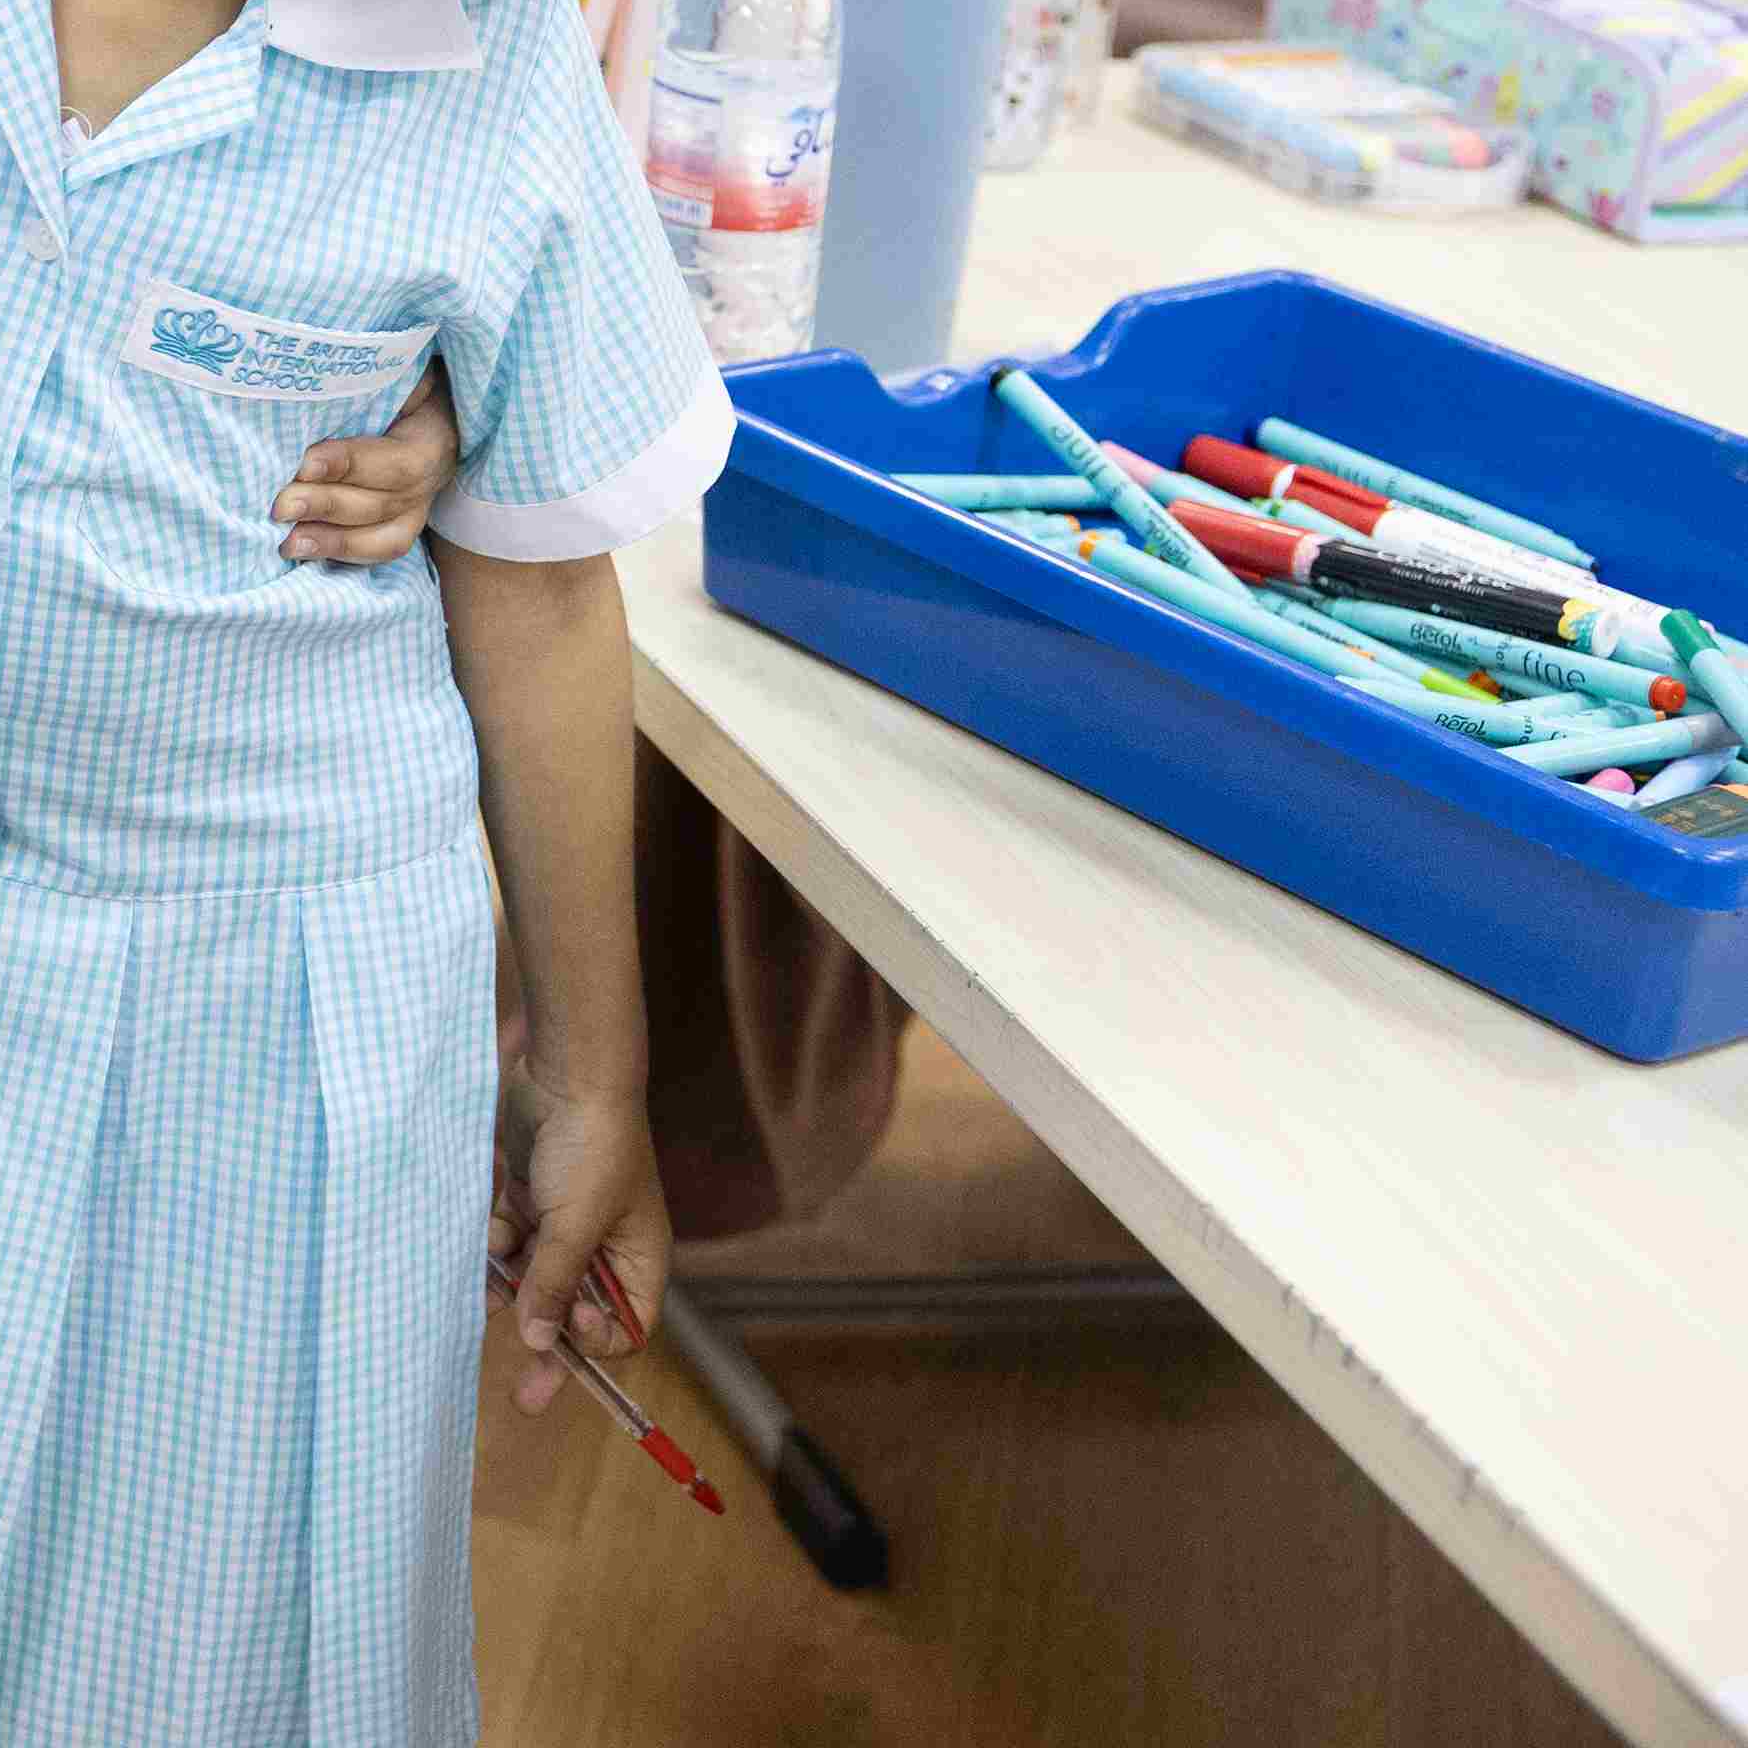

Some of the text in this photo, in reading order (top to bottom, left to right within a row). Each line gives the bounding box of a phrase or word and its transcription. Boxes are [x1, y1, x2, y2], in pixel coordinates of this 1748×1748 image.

[255, 329, 383, 360] THE BRITISH
[242, 347, 405, 376] INTERNATIONAL
[231, 366, 323, 392] SCHOOL
[1523, 649, 1586, 691] fine
[1434, 711, 1488, 737] Berol
